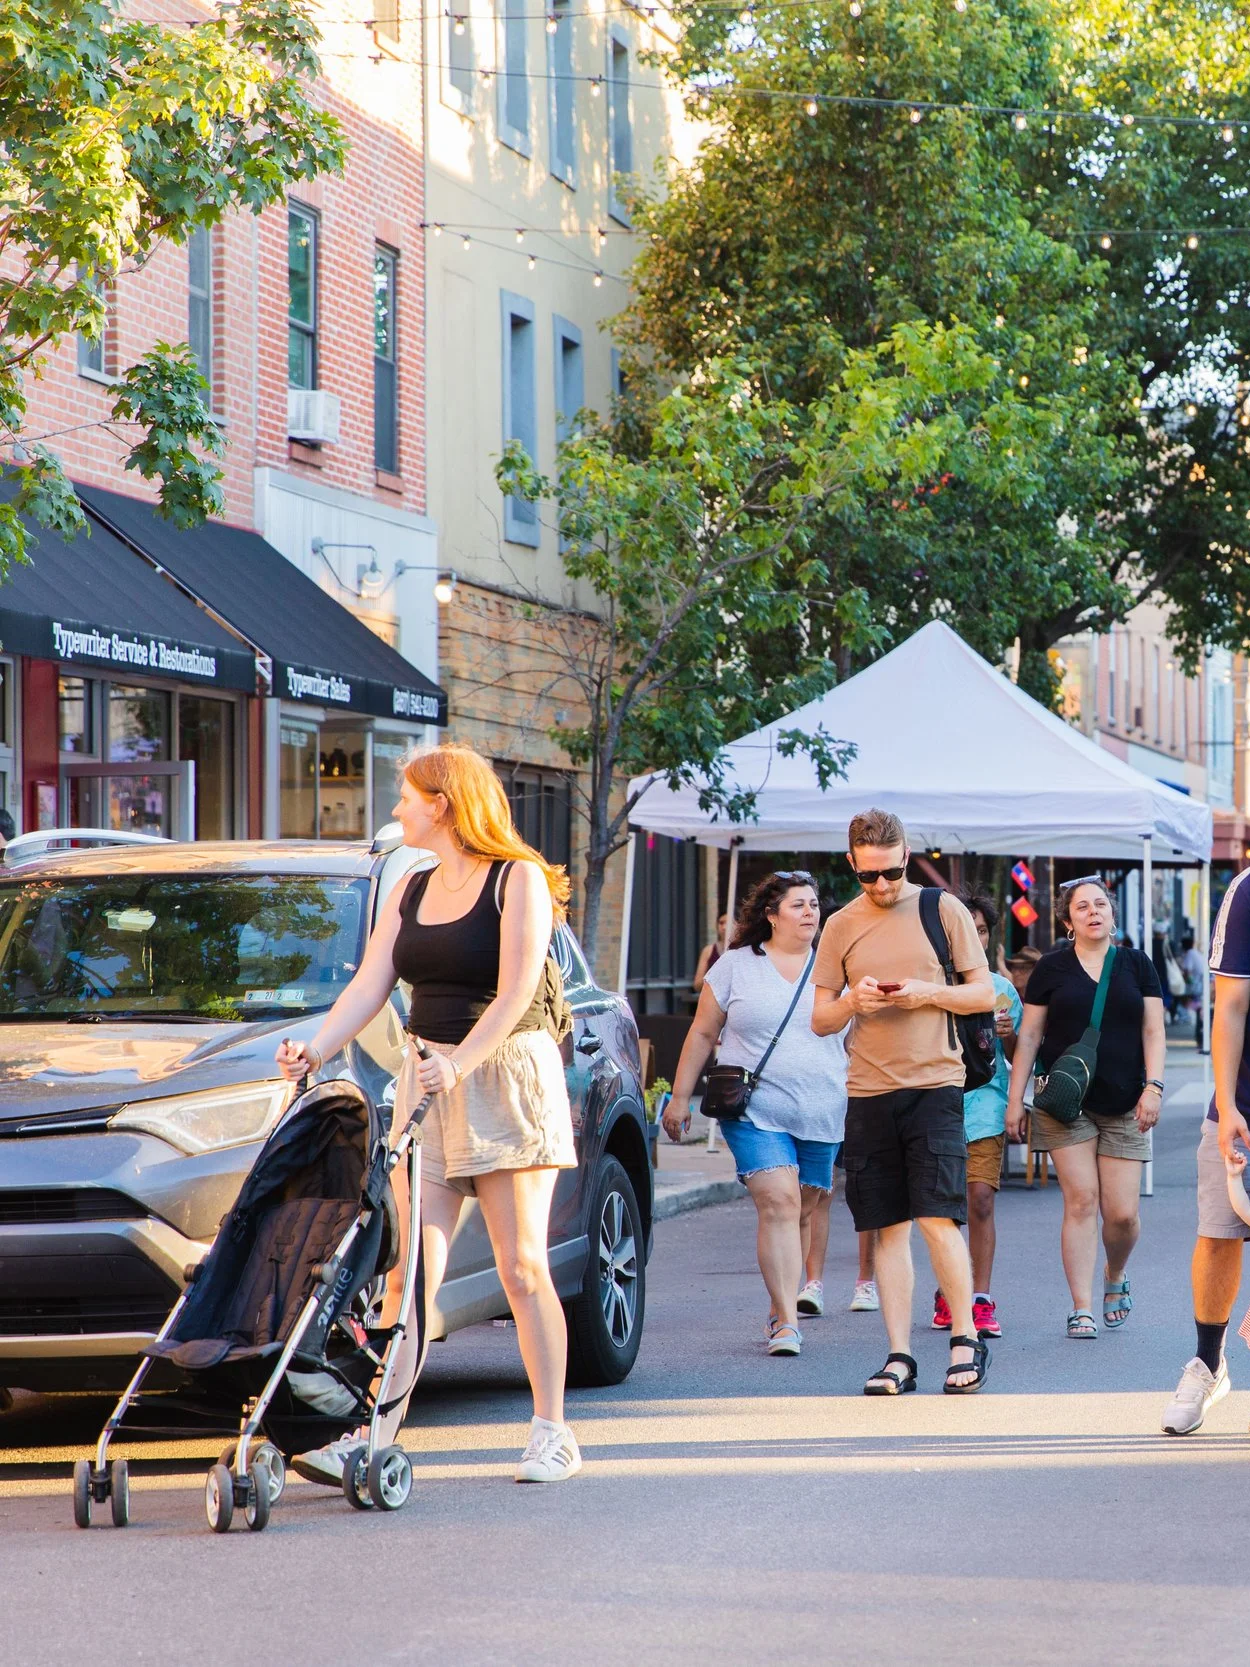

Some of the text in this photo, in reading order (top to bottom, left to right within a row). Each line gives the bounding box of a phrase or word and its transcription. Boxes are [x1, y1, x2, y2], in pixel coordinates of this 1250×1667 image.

[52, 622, 216, 677] Typewriter Service & Restorations
[287, 666, 330, 698] Typewriter
[330, 676, 351, 703] Sales
[265, 991, 273, 1000] 27
[295, 991, 303, 1000] 27
